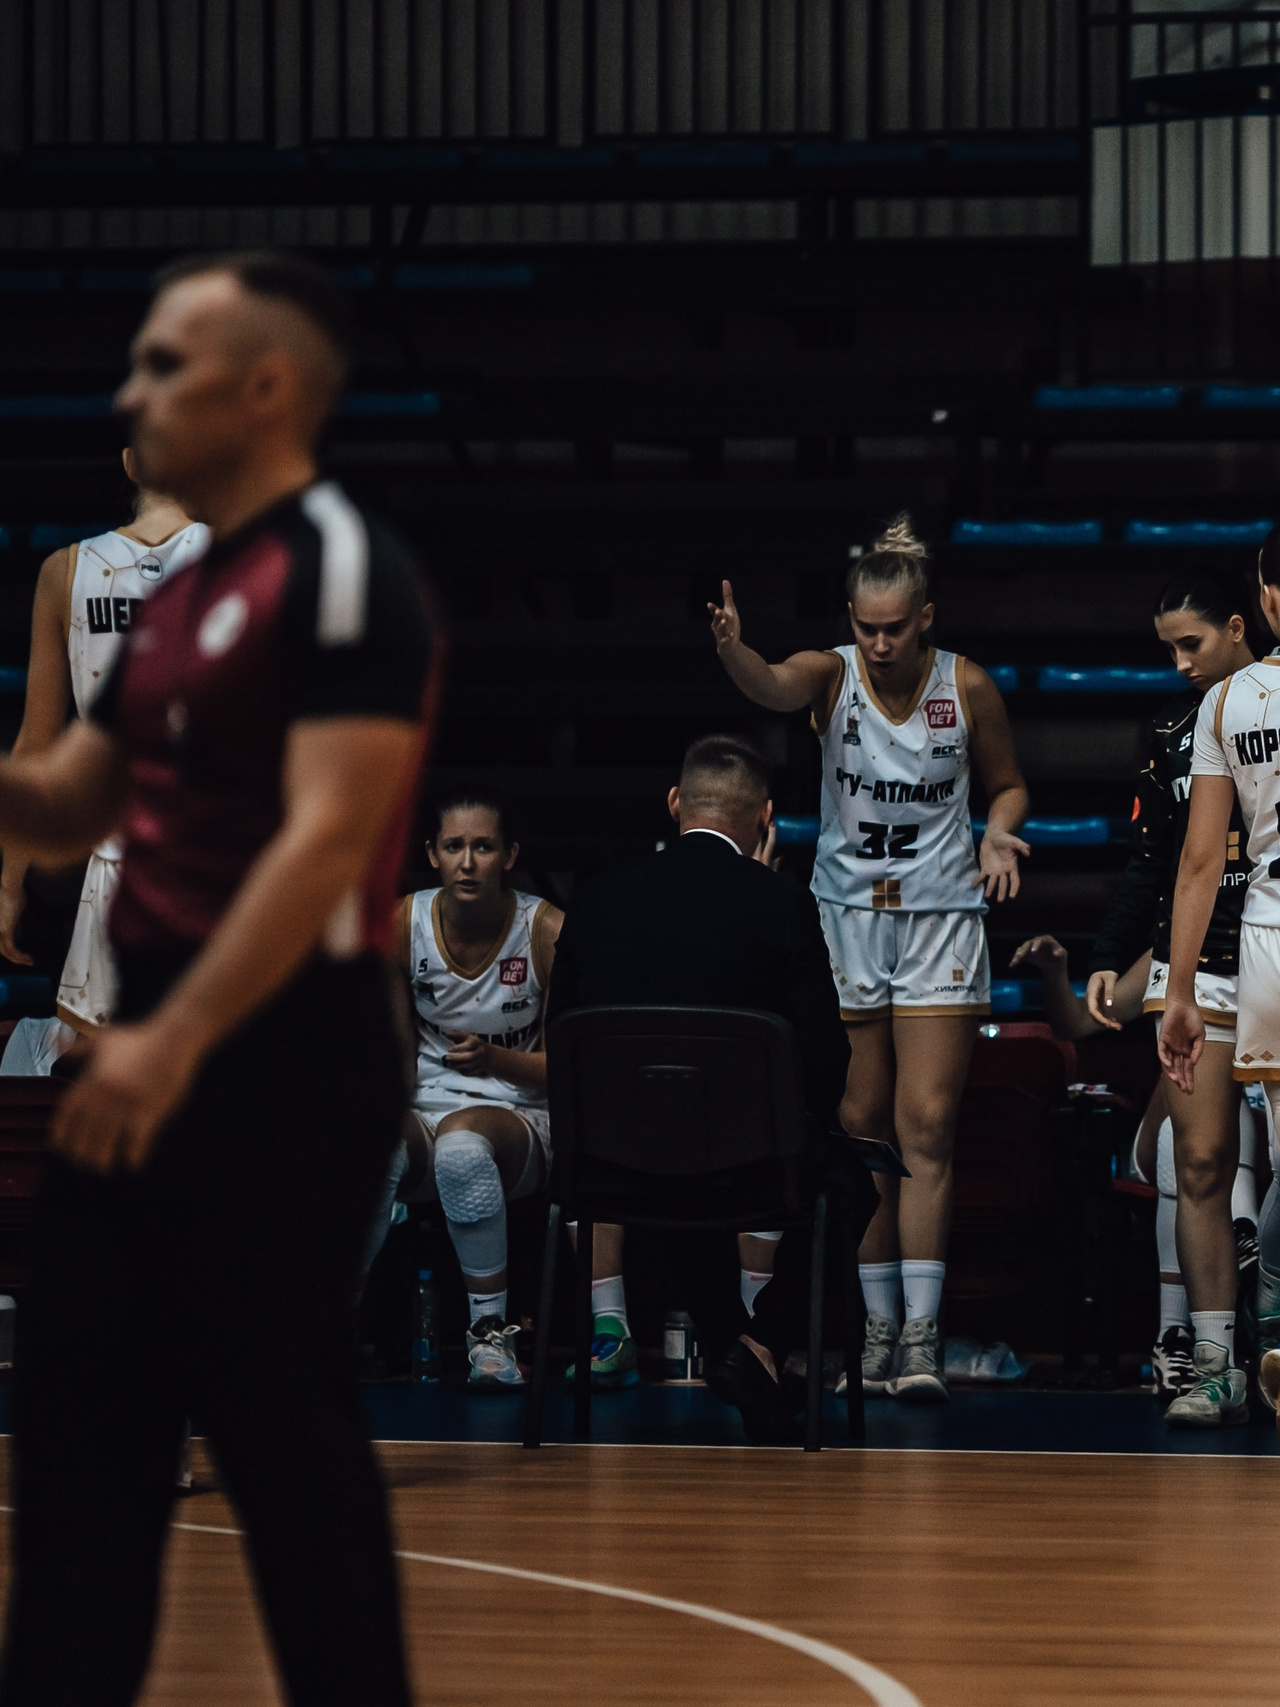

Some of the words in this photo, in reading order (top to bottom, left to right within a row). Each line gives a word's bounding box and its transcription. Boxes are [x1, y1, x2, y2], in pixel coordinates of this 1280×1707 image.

[929, 702, 954, 713] FON
[930, 713, 954, 725] BET
[855, 821, 920, 859] 32
